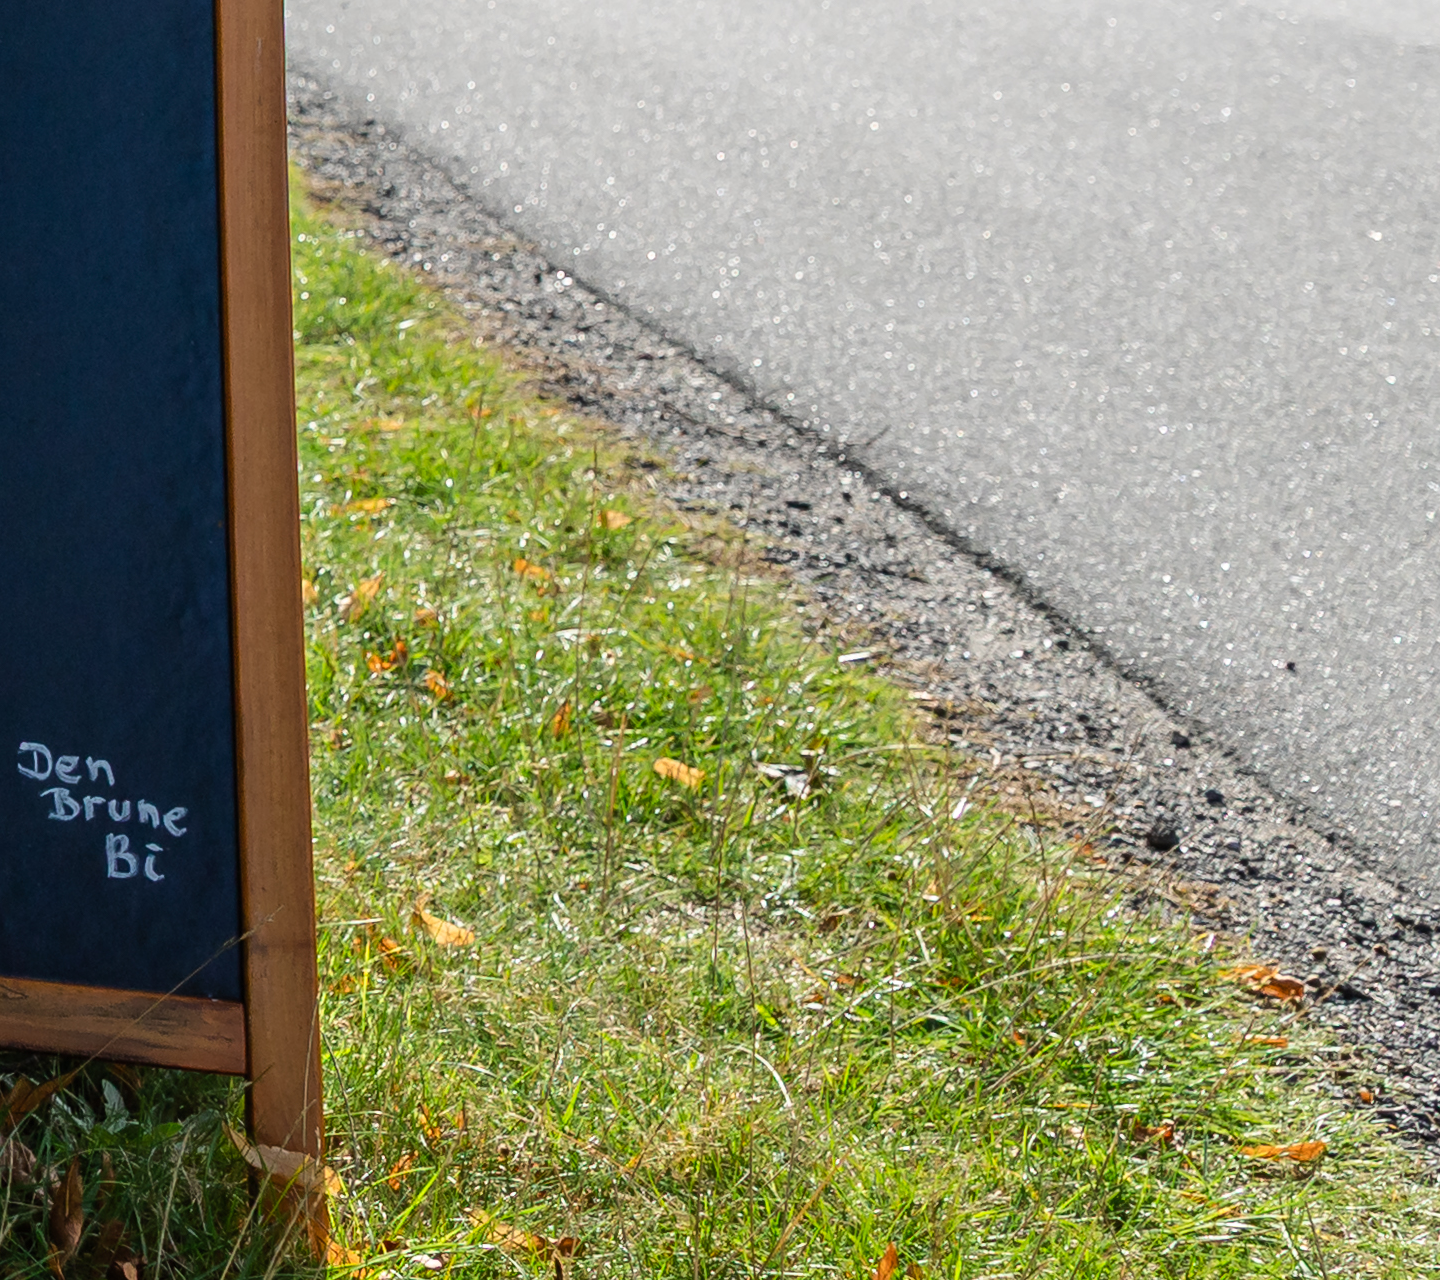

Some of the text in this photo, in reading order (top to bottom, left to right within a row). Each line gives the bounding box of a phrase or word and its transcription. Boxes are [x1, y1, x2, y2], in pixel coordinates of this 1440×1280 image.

[17, 741, 115, 786] Den
[40, 787, 188, 837] Brune
[106, 833, 165, 882] Bi
